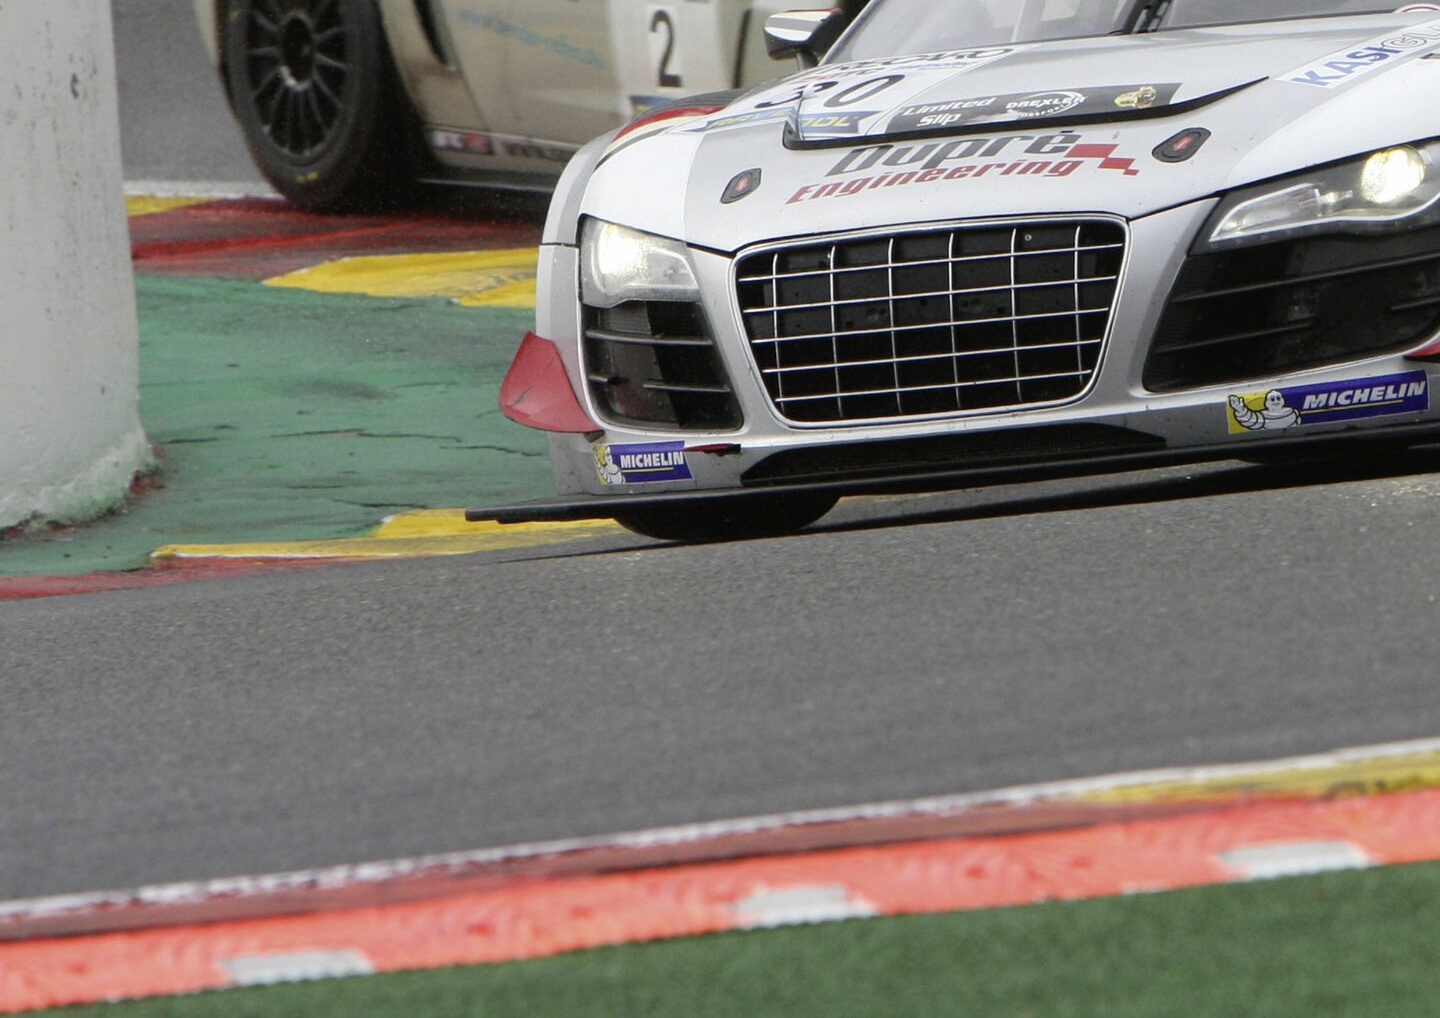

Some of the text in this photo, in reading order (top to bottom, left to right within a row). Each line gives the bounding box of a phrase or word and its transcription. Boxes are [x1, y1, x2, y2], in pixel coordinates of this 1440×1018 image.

[650, 9, 682, 87] 2
[754, 74, 906, 109] 30
[901, 96, 998, 117] Limited
[1005, 95, 1088, 109] DREXLER
[916, 112, 962, 127] Slip
[825, 130, 1083, 177] Dupré
[785, 157, 1085, 206] Engineering
[1302, 380, 1427, 411] MICHELIN
[620, 451, 685, 469] MICHELIN
